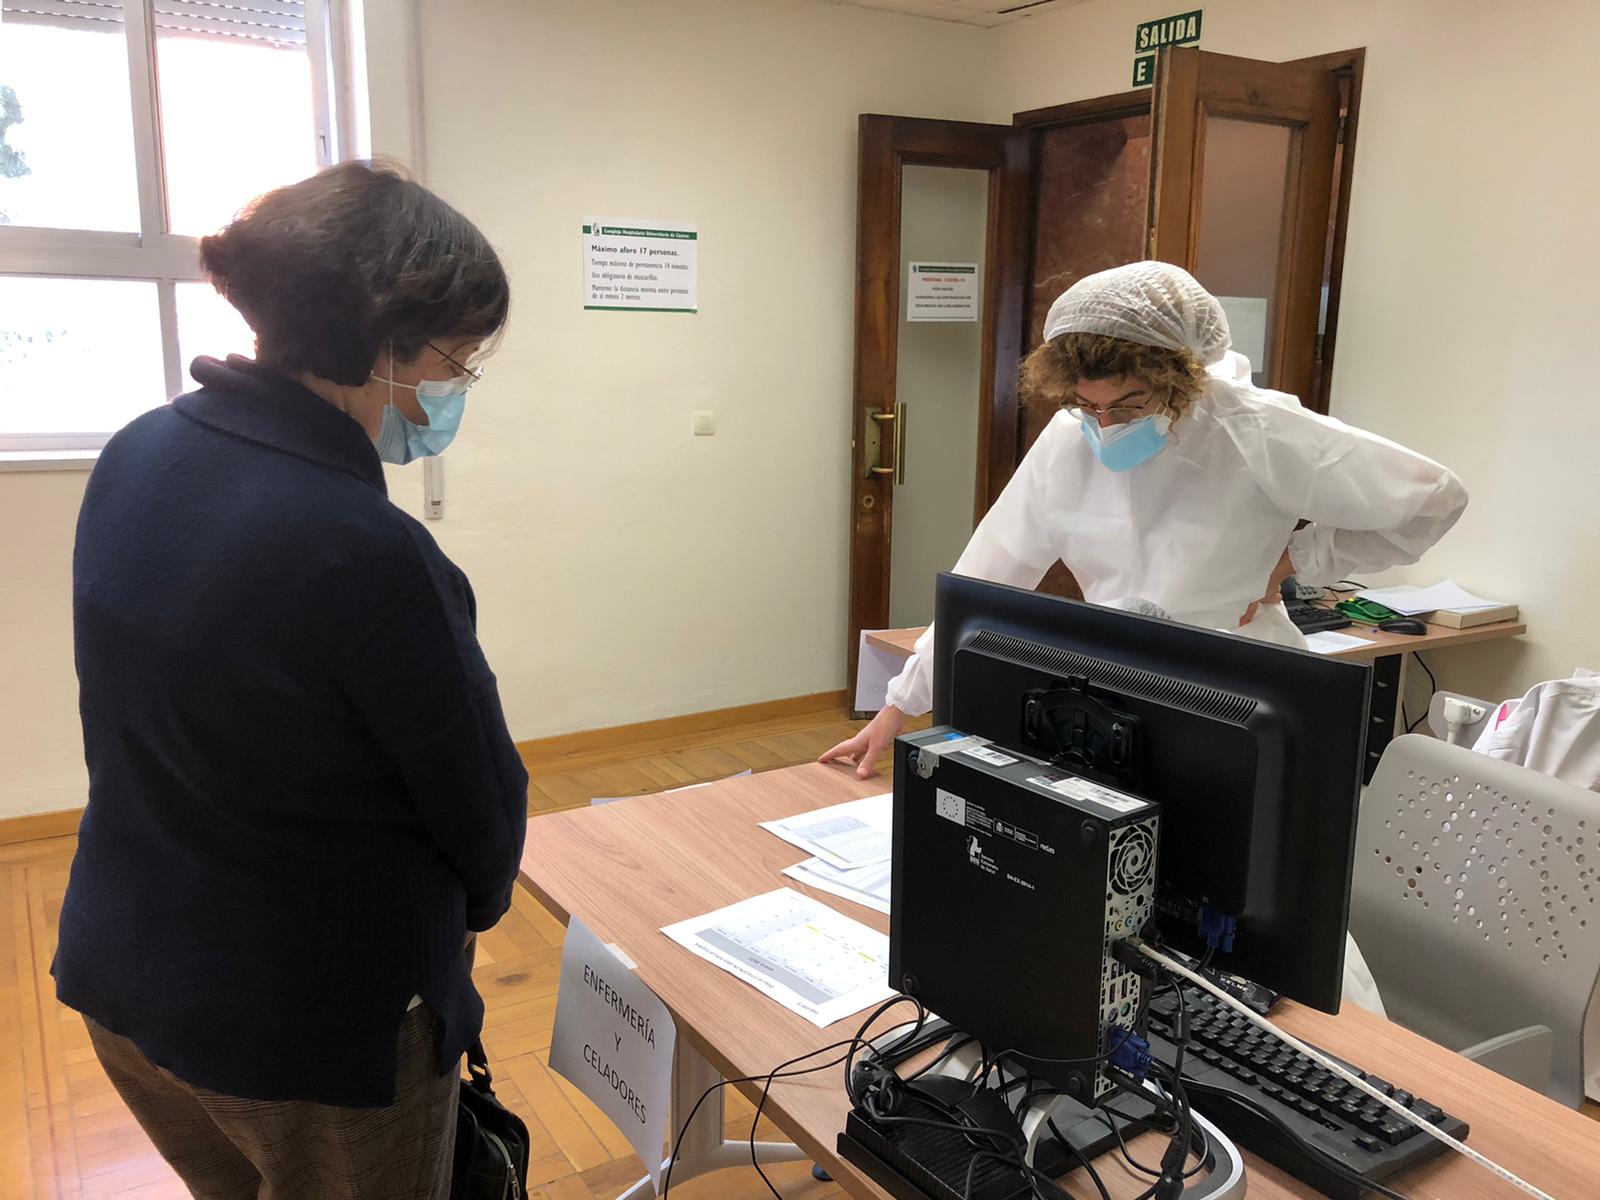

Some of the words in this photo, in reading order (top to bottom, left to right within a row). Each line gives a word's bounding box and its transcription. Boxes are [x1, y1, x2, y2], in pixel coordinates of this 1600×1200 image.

[1140, 16, 1196, 48] SALIDA
[591, 244, 618, 253] Máximo
[620, 245, 637, 254] aforo
[640, 246, 647, 255] 17
[649, 248, 679, 257] personas.
[592, 258, 608, 267] Tiempo
[635, 261, 663, 270] permanencia
[592, 271, 600, 279] Uso
[602, 272, 626, 281] obligatorio
[627, 272, 632, 280] de
[592, 284, 613, 292] Mantener
[614, 284, 619, 292] la
[620, 285, 639, 293] distancia
[584, 964, 656, 1050] ENFERMERÍA
[614, 1032, 622, 1052] Y
[583, 1044, 647, 1124] CELADORES
